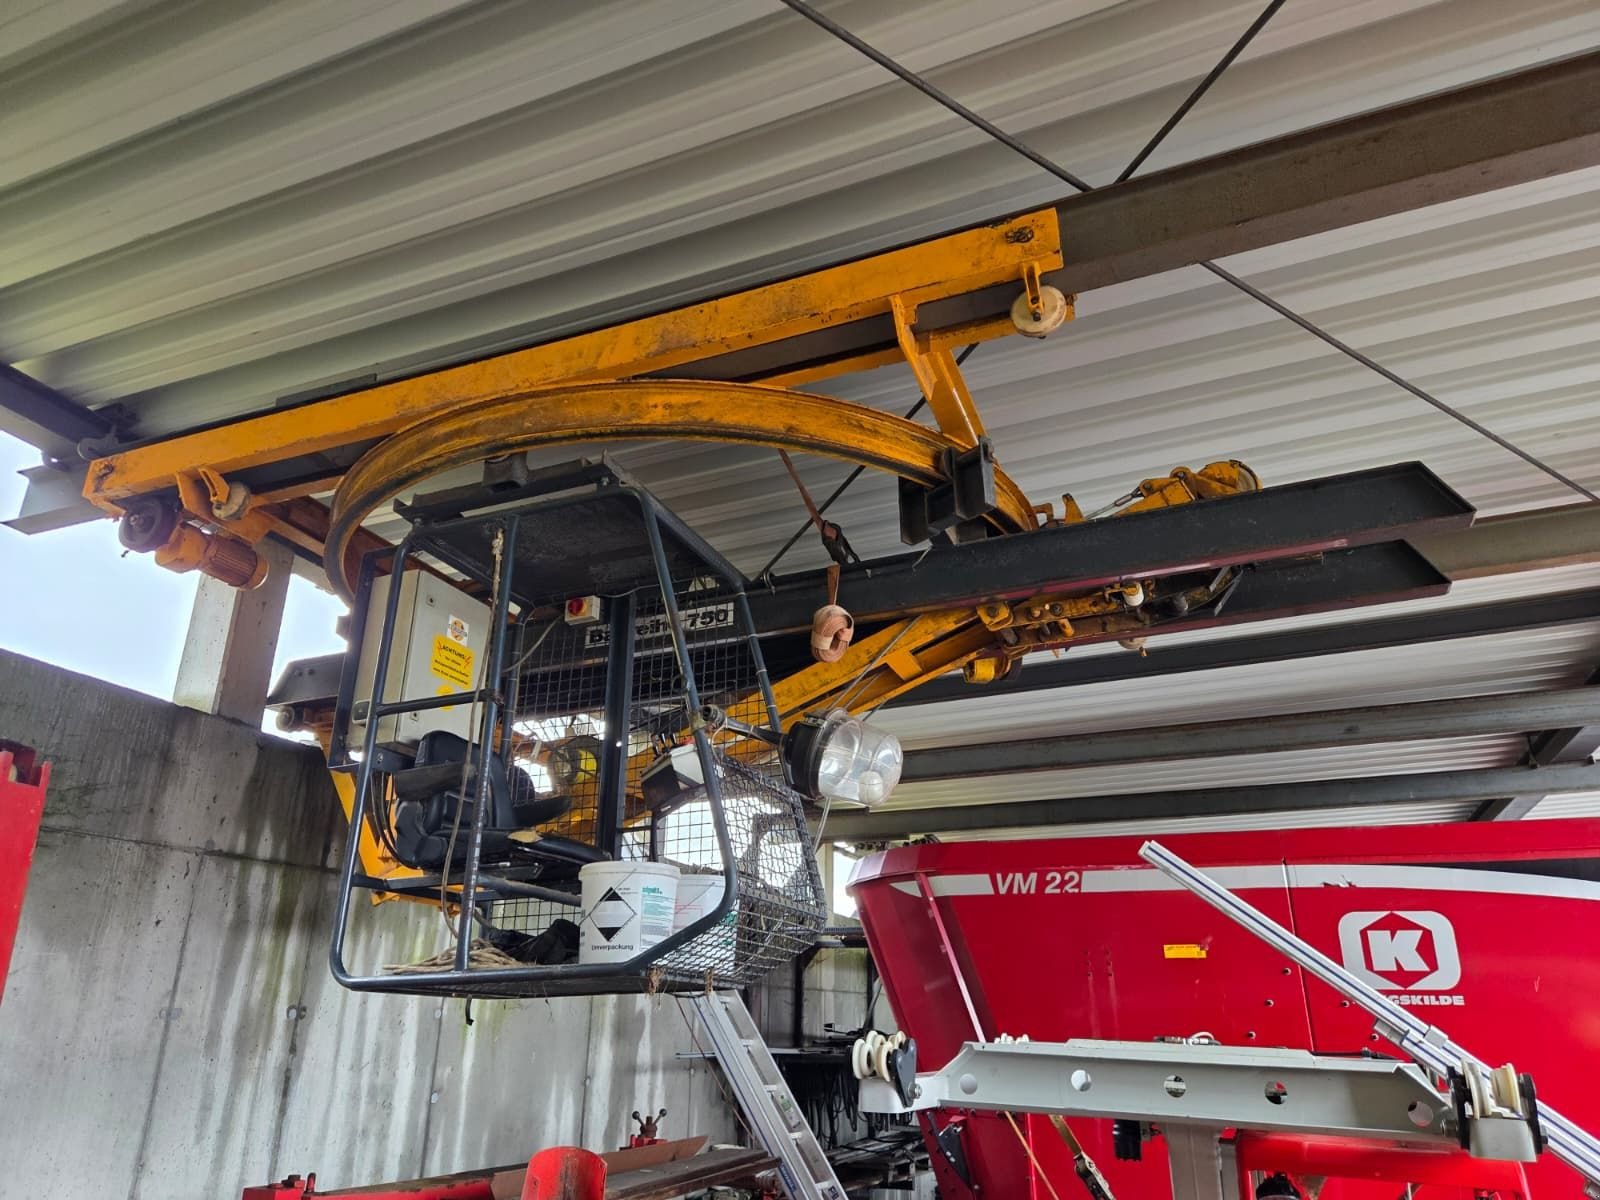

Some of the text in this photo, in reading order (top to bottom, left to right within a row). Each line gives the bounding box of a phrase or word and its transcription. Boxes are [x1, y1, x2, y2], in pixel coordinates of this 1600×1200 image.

[687, 608, 729, 628] 750
[996, 871, 1080, 895] VM 22
[1367, 930, 1430, 971] K
